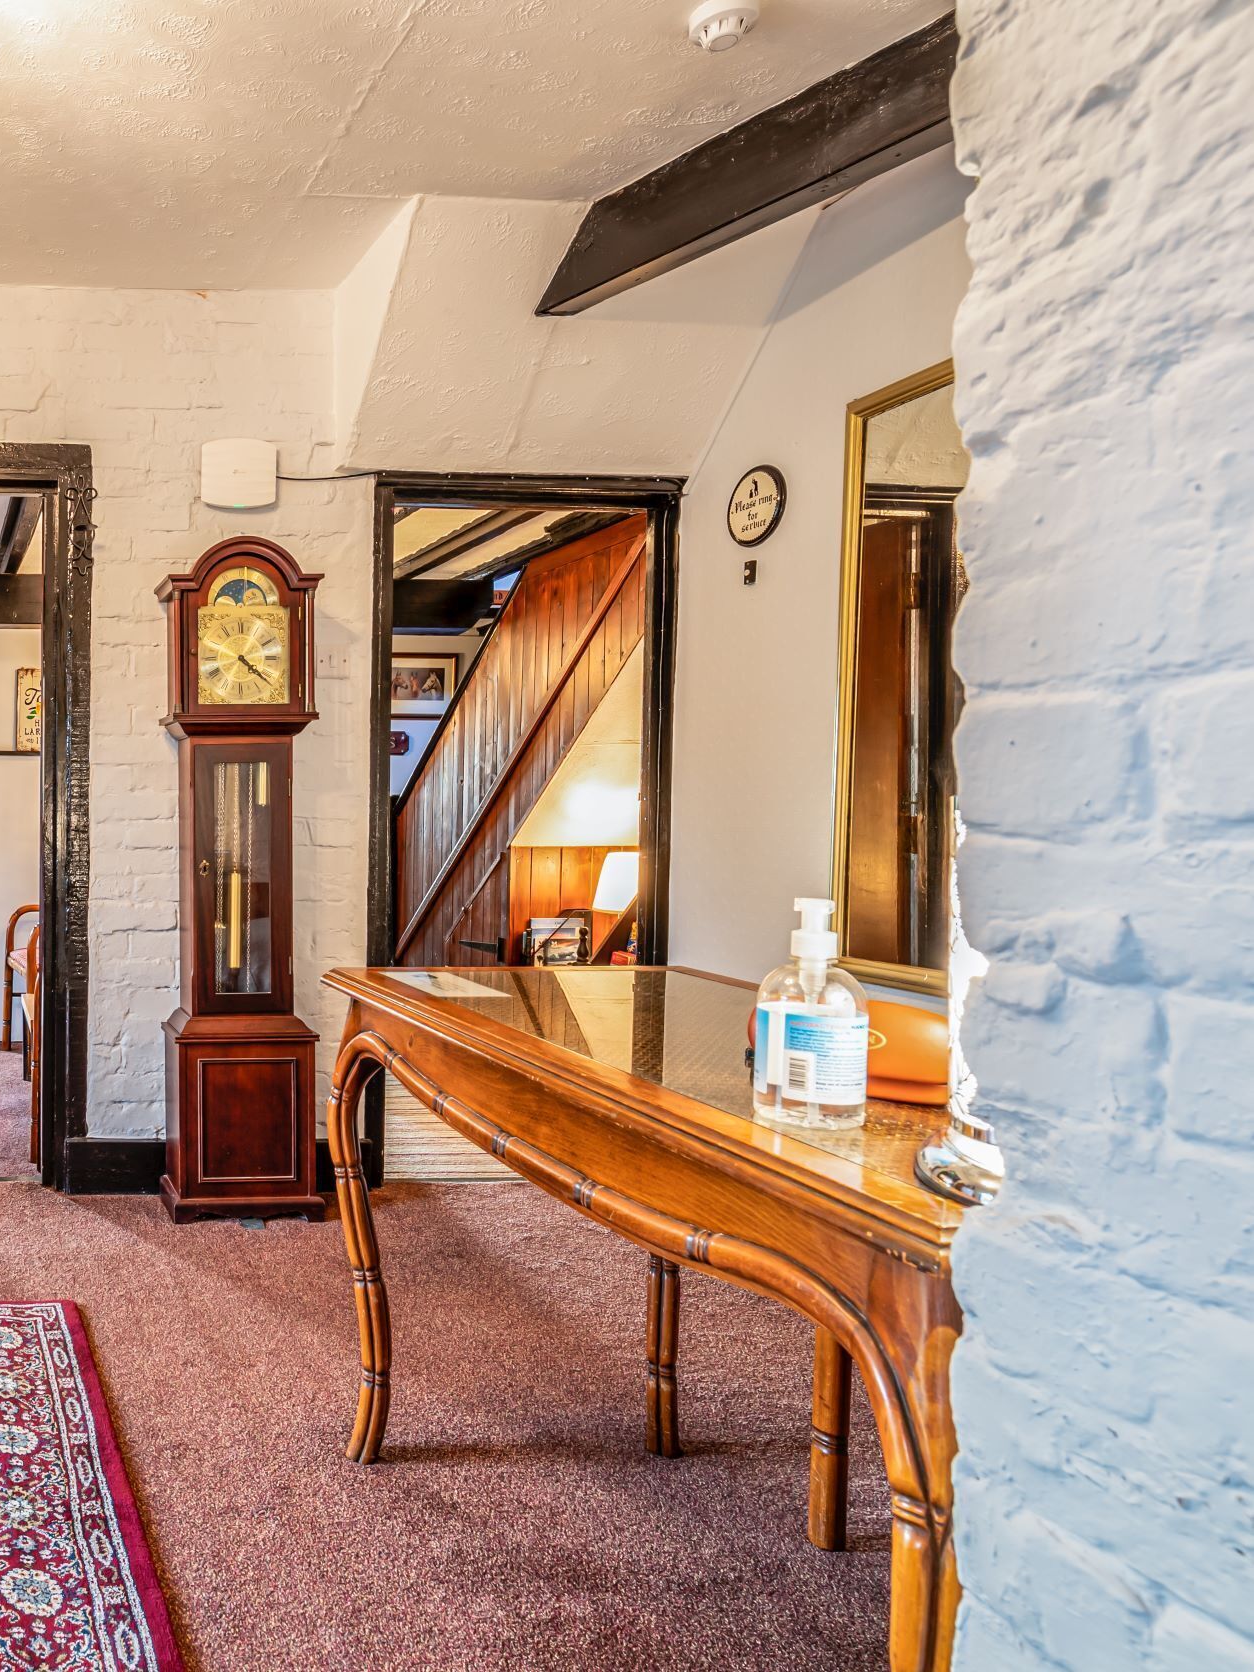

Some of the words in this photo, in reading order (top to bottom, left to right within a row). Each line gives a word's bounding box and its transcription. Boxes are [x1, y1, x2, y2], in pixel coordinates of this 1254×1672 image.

[735, 500, 756, 514] Please
[758, 494, 773, 505] ring
[747, 510, 758, 521] for
[741, 519, 766, 532] service
